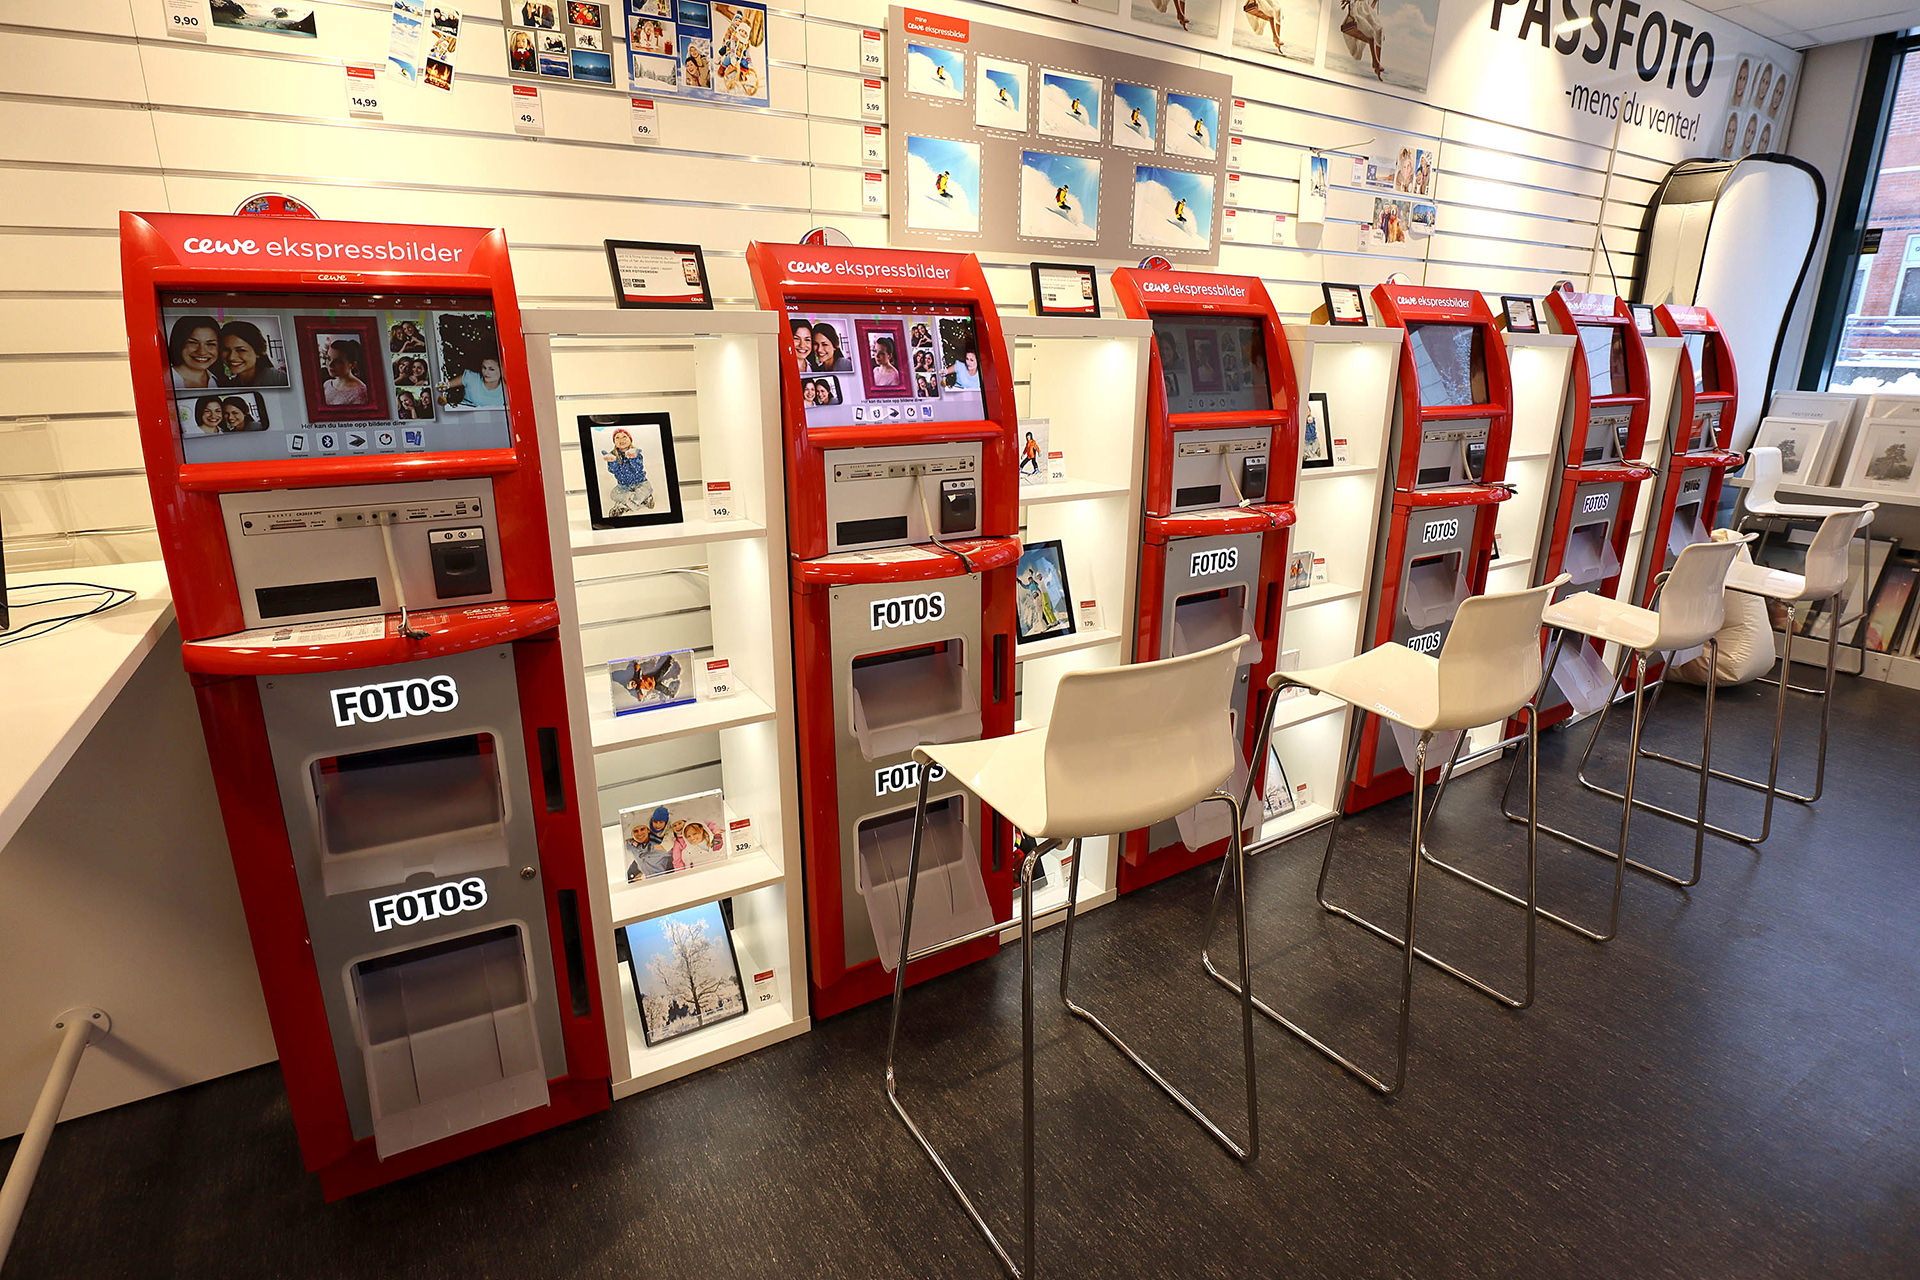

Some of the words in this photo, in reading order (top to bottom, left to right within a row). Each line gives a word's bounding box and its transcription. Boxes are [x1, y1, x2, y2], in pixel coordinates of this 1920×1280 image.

[173, 15, 199, 26] 9,90
[908, 22, 924, 31] cewe
[925, 25, 966, 39] ekspressbilder
[352, 97, 378, 107] 14,99
[1622, 94, 1644, 126] du
[1648, 106, 1701, 142] venter!
[183, 236, 260, 256] cewe
[266, 236, 462, 263] ekspressbilder
[317, 273, 348, 282] cewe
[788, 259, 833, 274] cewe
[836, 260, 951, 280] ekspressbilder
[1142, 281, 1172, 293] cewe
[1173, 281, 1245, 297] ekspressbilder
[172, 296, 198, 305] cewe
[1397, 296, 1418, 305] cewe
[1417, 296, 1470, 308] ekspressbilder
[1584, 495, 1608, 511] FOTOS
[1425, 520, 1457, 540] FOTOS
[1192, 550, 1236, 574] FOTOS
[873, 595, 942, 627] FOTOS
[336, 679, 454, 722] FOTOS
[374, 880, 484, 927] FOTOS
